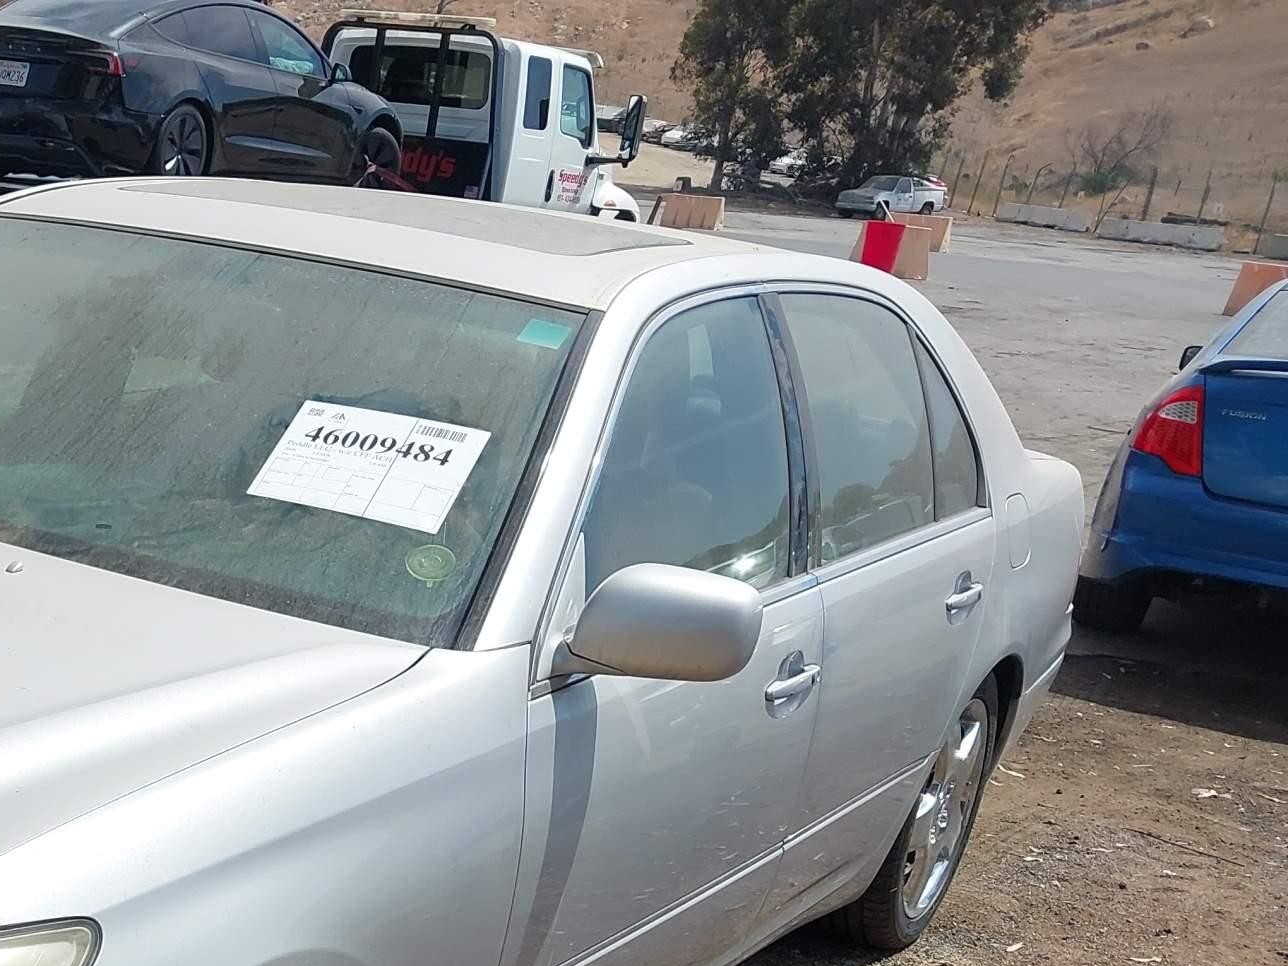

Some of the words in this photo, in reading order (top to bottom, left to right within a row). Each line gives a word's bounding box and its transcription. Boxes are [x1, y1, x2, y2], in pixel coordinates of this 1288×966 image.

[402, 147, 456, 182] dy's
[1221, 408, 1267, 421] FUSION
[305, 425, 454, 467] 46009484
